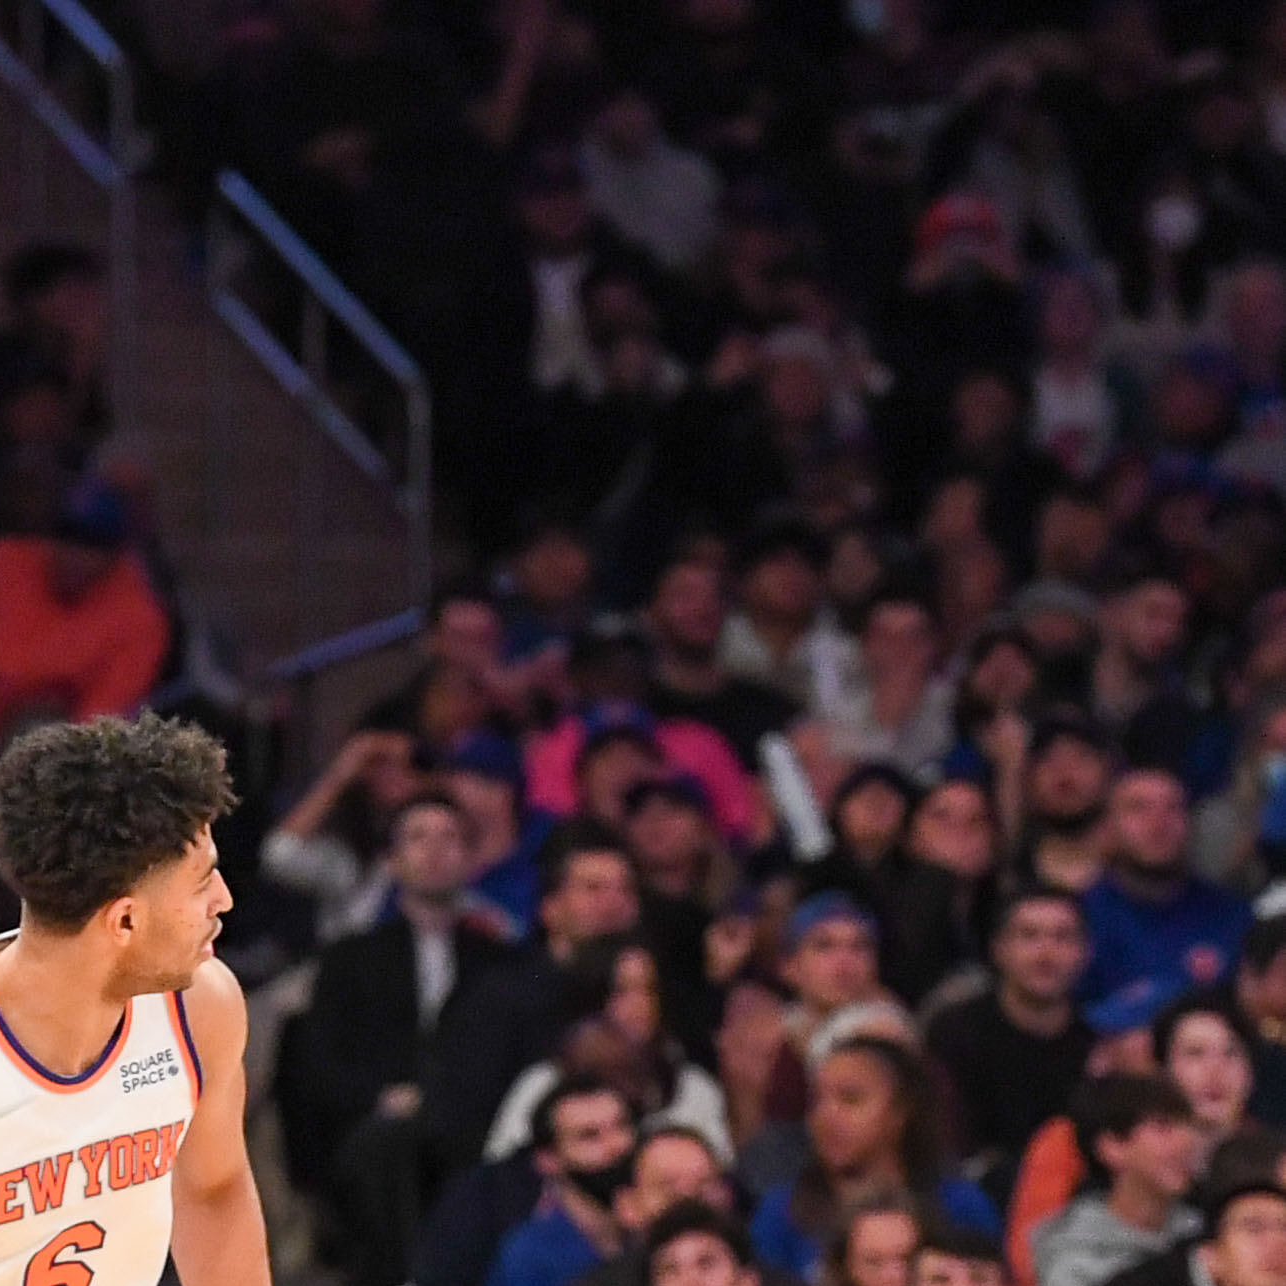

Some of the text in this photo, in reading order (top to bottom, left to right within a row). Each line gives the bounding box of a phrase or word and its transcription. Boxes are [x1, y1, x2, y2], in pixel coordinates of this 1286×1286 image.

[120, 1048, 174, 1078] SQUARE
[122, 1068, 166, 1094] SPACE
[77, 1119, 185, 1198] YORK
